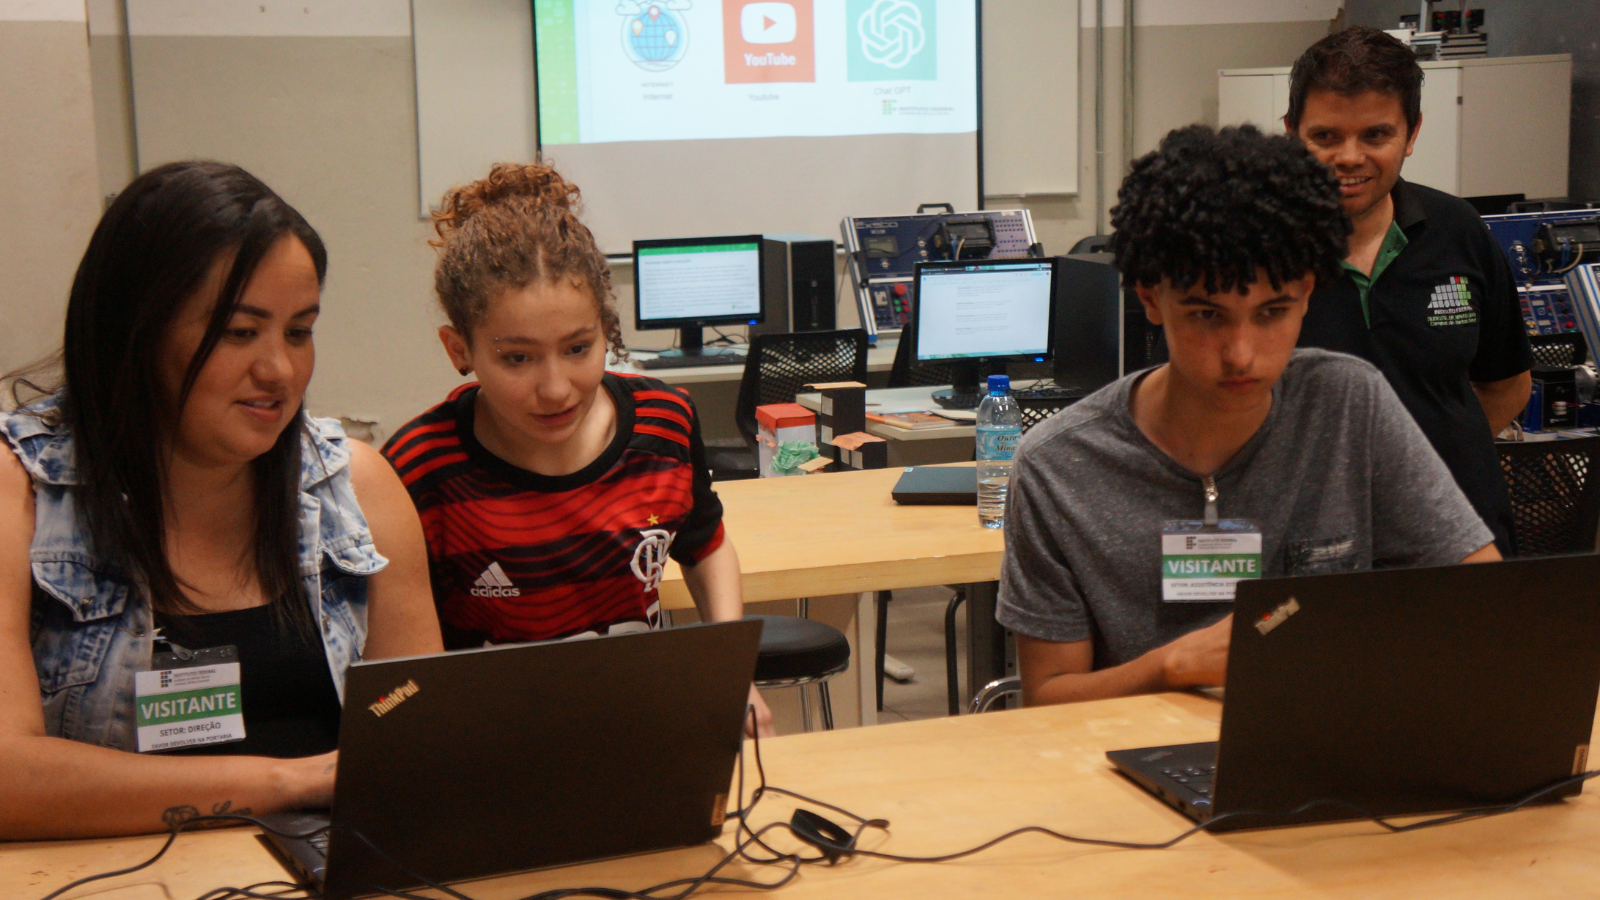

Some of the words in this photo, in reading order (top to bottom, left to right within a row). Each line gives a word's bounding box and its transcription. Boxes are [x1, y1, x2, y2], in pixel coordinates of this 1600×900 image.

[744, 52, 796, 67] YouTube
[894, 86, 912, 94] GPT
[1168, 559, 1256, 574] VISITANTE
[470, 586, 521, 598] adidas
[141, 692, 236, 720] VISITANTE
[160, 727, 187, 738] SETOR:
[188, 722, 221, 733] DIREÇÃO
[170, 738, 196, 747] DEVOLVER
[206, 733, 232, 742] PORTARIA
